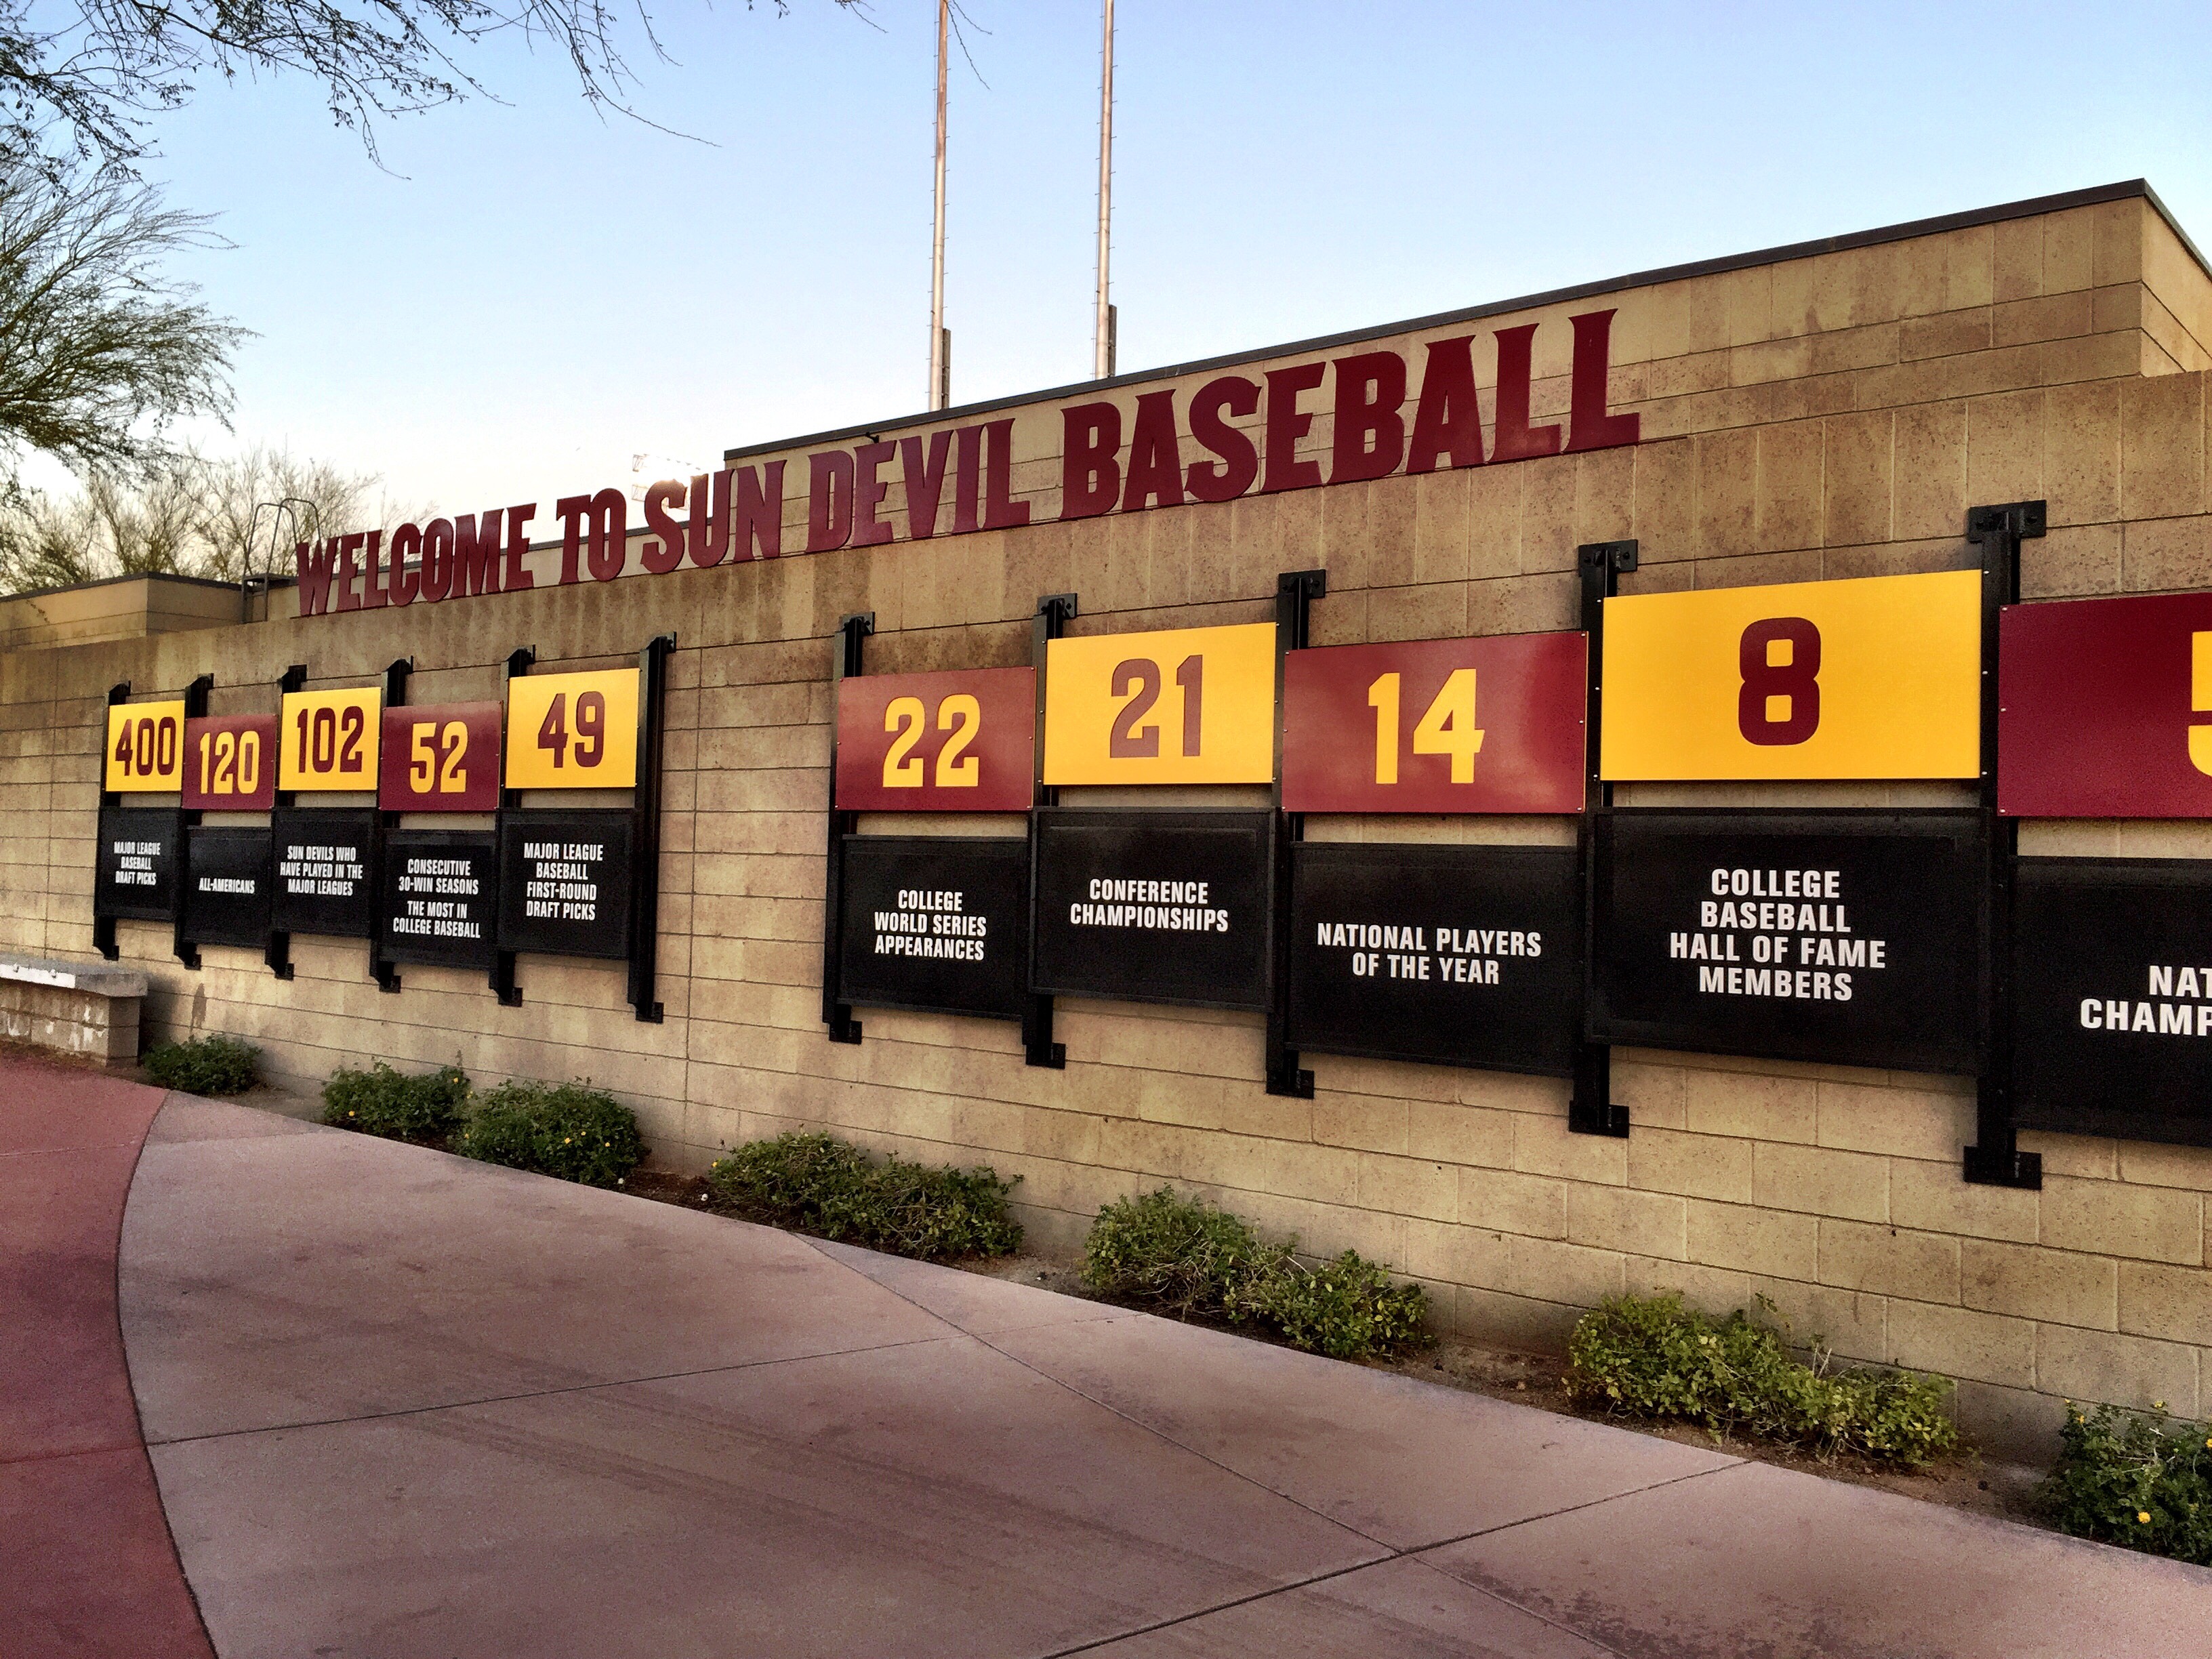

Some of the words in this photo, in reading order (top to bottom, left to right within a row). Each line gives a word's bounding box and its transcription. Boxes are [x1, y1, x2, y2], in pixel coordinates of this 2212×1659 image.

[297, 504, 537, 618] WELCOME
[556, 488, 627, 586] TO
[641, 459, 787, 575] SUN
[808, 417, 1030, 554] DEVIL
[1061, 308, 1640, 520] BASEBALL
[1738, 617, 1821, 745] 8
[1110, 655, 1202, 758] 21
[298, 706, 363, 773] 102
[538, 691, 605, 768] 49
[1368, 669, 1485, 784] 14
[115, 717, 176, 776] 400
[883, 695, 980, 787] 22
[200, 731, 260, 794] 120
[411, 722, 468, 792] 52
[113, 841, 136, 855] MAJOR
[137, 842, 161, 856] LEAGUE
[287, 846, 304, 860] SUN
[306, 846, 333, 861] DEVILS
[336, 846, 356, 862] WHO
[524, 842, 559, 859] MAJOR
[562, 844, 604, 861] LEAGUE
[121, 856, 152, 870] BASEBALL
[279, 862, 301, 877] HAVE
[303, 863, 333, 878] PLAYED
[335, 864, 345, 878] IN
[346, 864, 363, 880] THE
[407, 859, 471, 876] CONSECUTIVE
[536, 862, 588, 880] BASEBALL
[115, 871, 136, 884] DRAFT
[137, 872, 157, 886] PICKS
[199, 878, 255, 894] ALL-AMERICANS
[287, 879, 315, 894] MAJOR
[317, 880, 354, 897] LEAGUES
[398, 876, 433, 893] 30-WIN
[436, 878, 479, 895] SEASONS
[527, 882, 597, 901] FIRST-ROUND
[1089, 878, 1208, 905] CONFERENCE
[1711, 868, 1841, 899] COLLEGE
[407, 901, 424, 916] THE
[427, 901, 454, 918] MOST
[457, 903, 468, 919] IN
[526, 901, 560, 919] DRAFT
[562, 902, 596, 921] PICKS
[898, 890, 963, 912] COLLEGE
[393, 918, 431, 935] COLLEGE
[434, 920, 480, 939] BASEBALL
[874, 912, 928, 934] WORLD
[933, 915, 987, 937] SERIES
[1070, 903, 1229, 933] CHAMPIONSHIPS
[1700, 901, 1851, 933] BASEBALL
[874, 935, 985, 962] APPEARANCES
[1317, 922, 1427, 951] NATIONAL
[1435, 927, 1542, 958] PLAYERS
[1668, 932, 1740, 962] HALL
[1751, 935, 1789, 964] OF
[1800, 938, 1887, 970] FAME
[1351, 952, 1380, 977] OF
[1387, 954, 1431, 981] THE
[1438, 957, 1500, 985] YEAR
[1698, 966, 1853, 1002] MEMBERS
